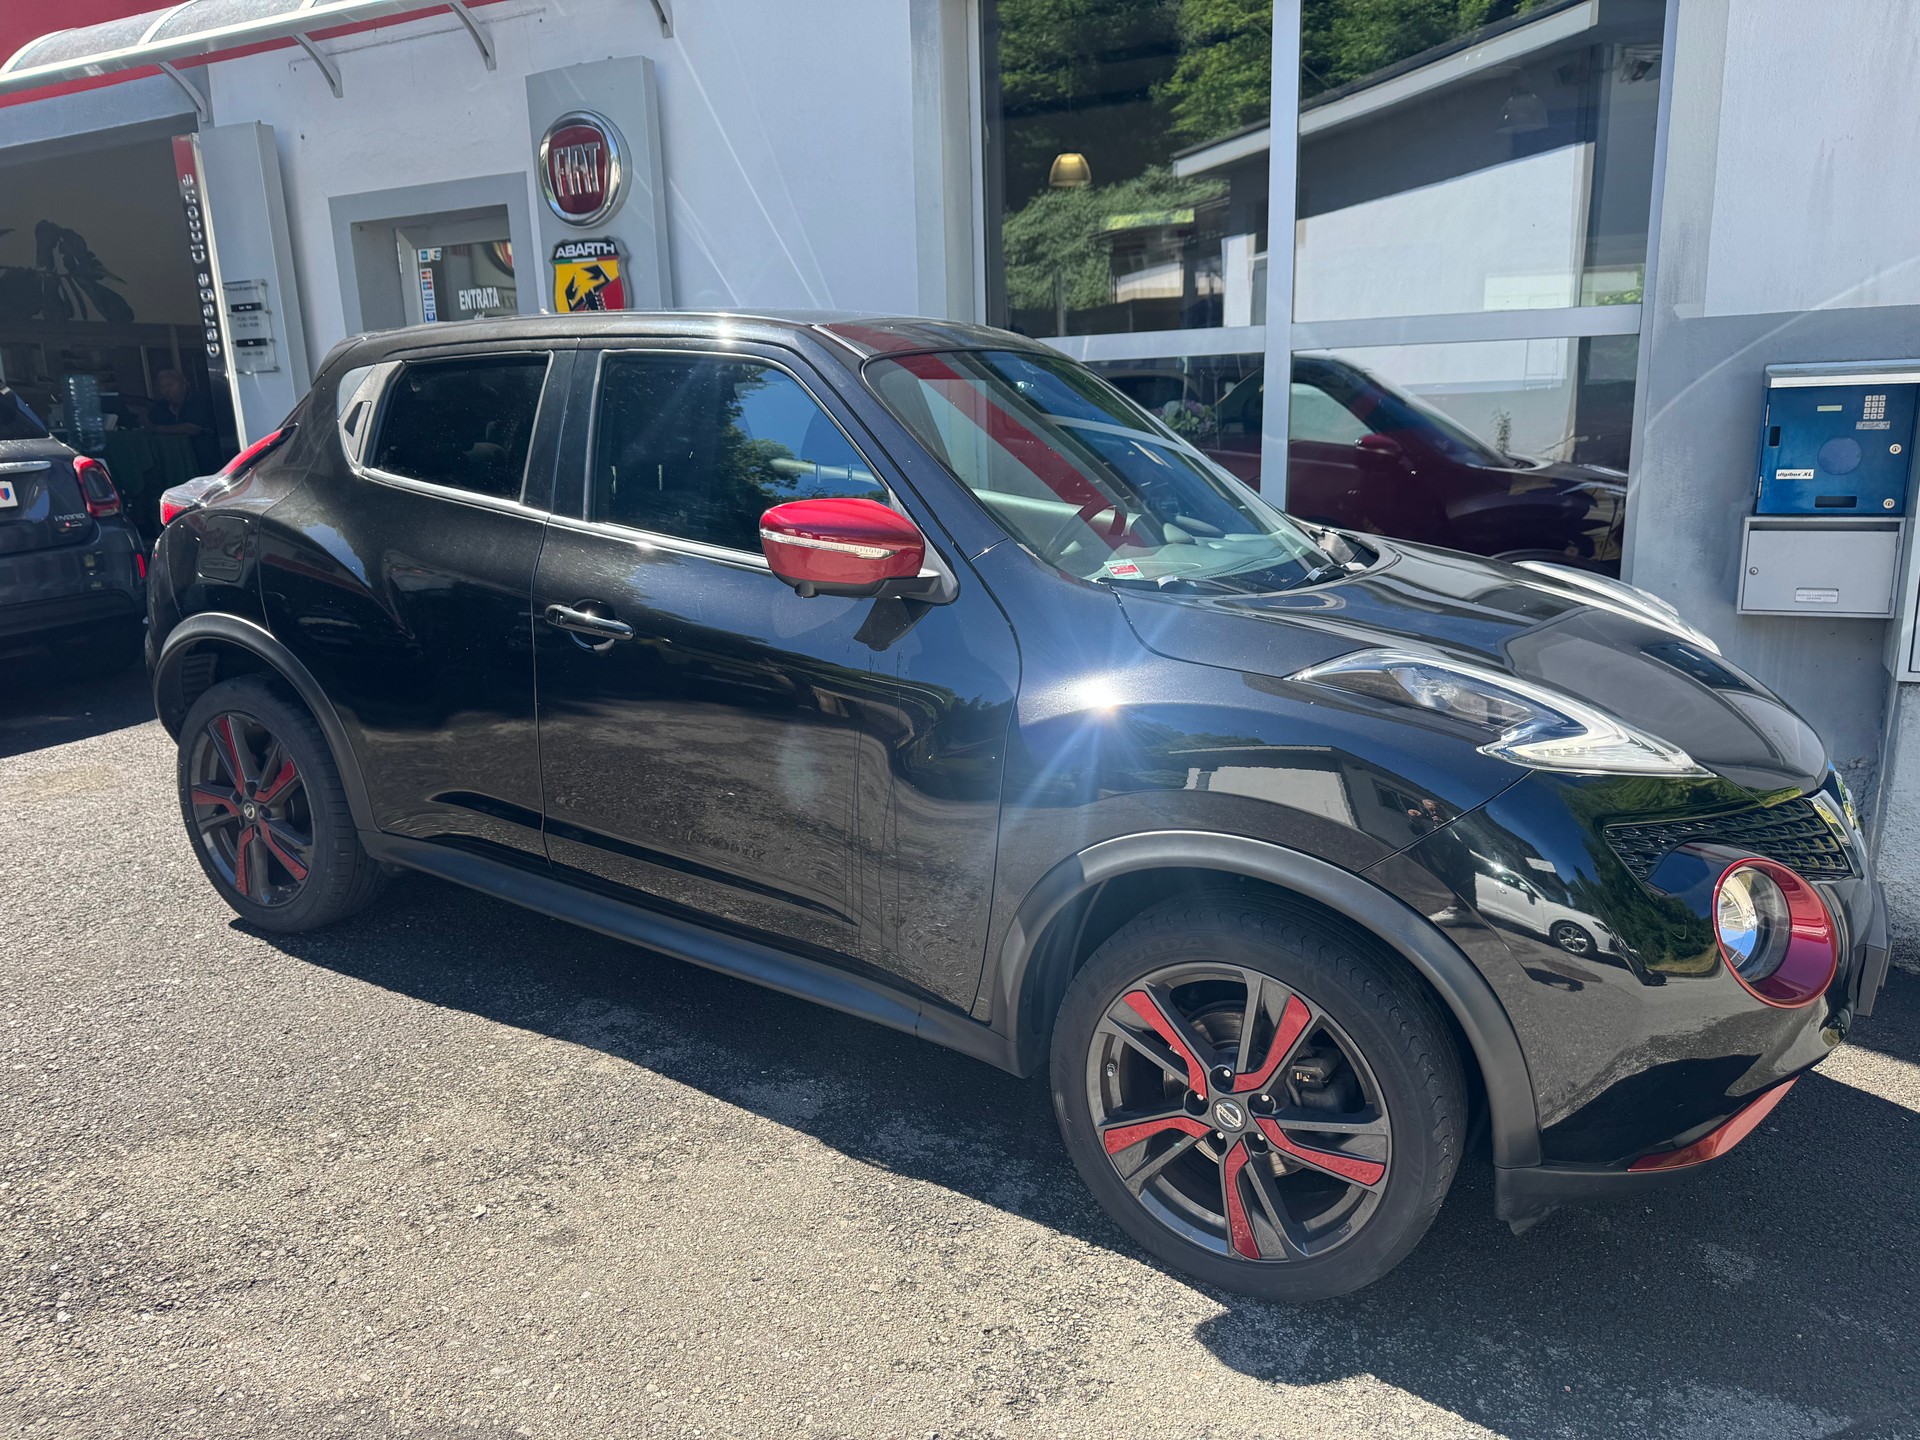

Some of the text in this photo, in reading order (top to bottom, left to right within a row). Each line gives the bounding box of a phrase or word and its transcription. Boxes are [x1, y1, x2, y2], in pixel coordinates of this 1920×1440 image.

[553, 141, 600, 197] FIAT
[182, 173, 220, 358] Garage Ciccone
[555, 241, 615, 259] ABARTH
[458, 286, 501, 311] ENTRATA
